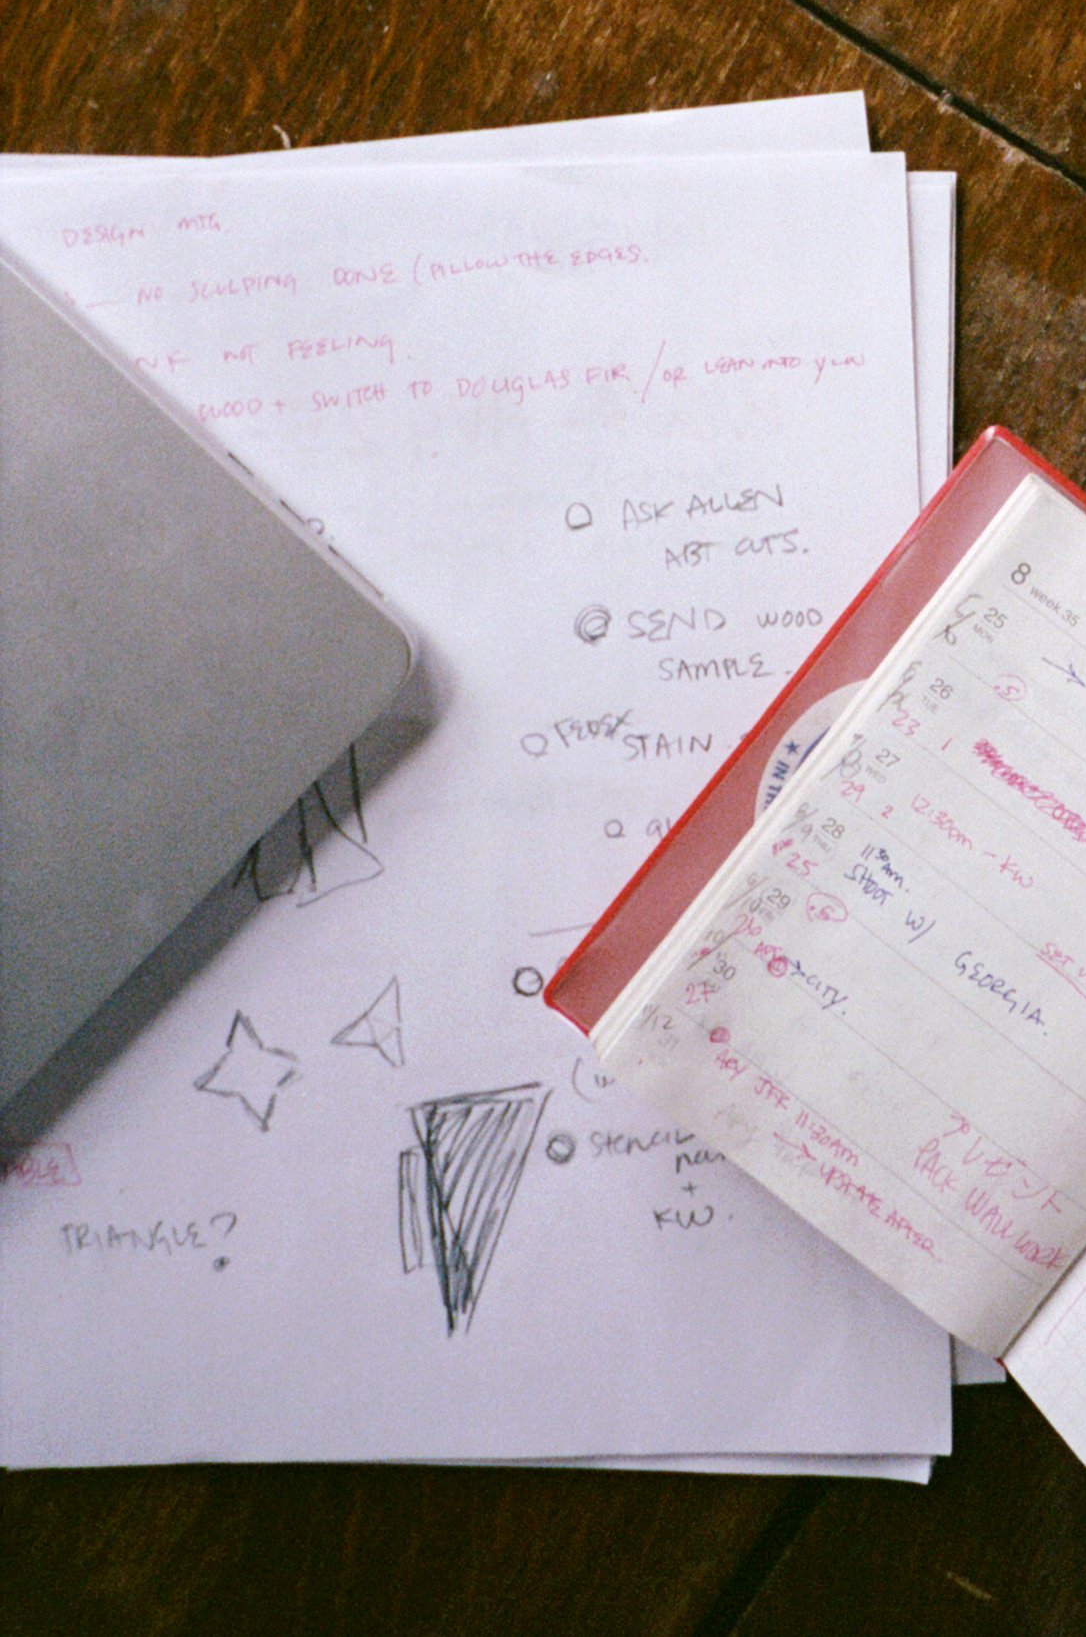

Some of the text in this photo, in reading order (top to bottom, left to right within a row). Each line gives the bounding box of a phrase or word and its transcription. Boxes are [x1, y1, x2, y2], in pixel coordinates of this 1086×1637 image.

[135, 284, 164, 306] NO
[332, 262, 399, 287] DONE
[311, 382, 387, 413] SWITCH
[408, 380, 434, 400] TO
[457, 368, 571, 406] DOUGLAS
[622, 483, 785, 530] ASK ALLEN
[664, 540, 724, 570] ABT
[1010, 562, 1081, 628] 8 week 35
[627, 606, 824, 642] SEND WOOD
[973, 607, 1008, 644] 25 MON
[929, 677, 954, 701] 26
[622, 733, 714, 762] STAIN
[875, 747, 900, 768] 27
[821, 816, 846, 840] 28
[786, 852, 819, 877] 25
[766, 887, 792, 911] 29
[712, 959, 737, 982] 30
